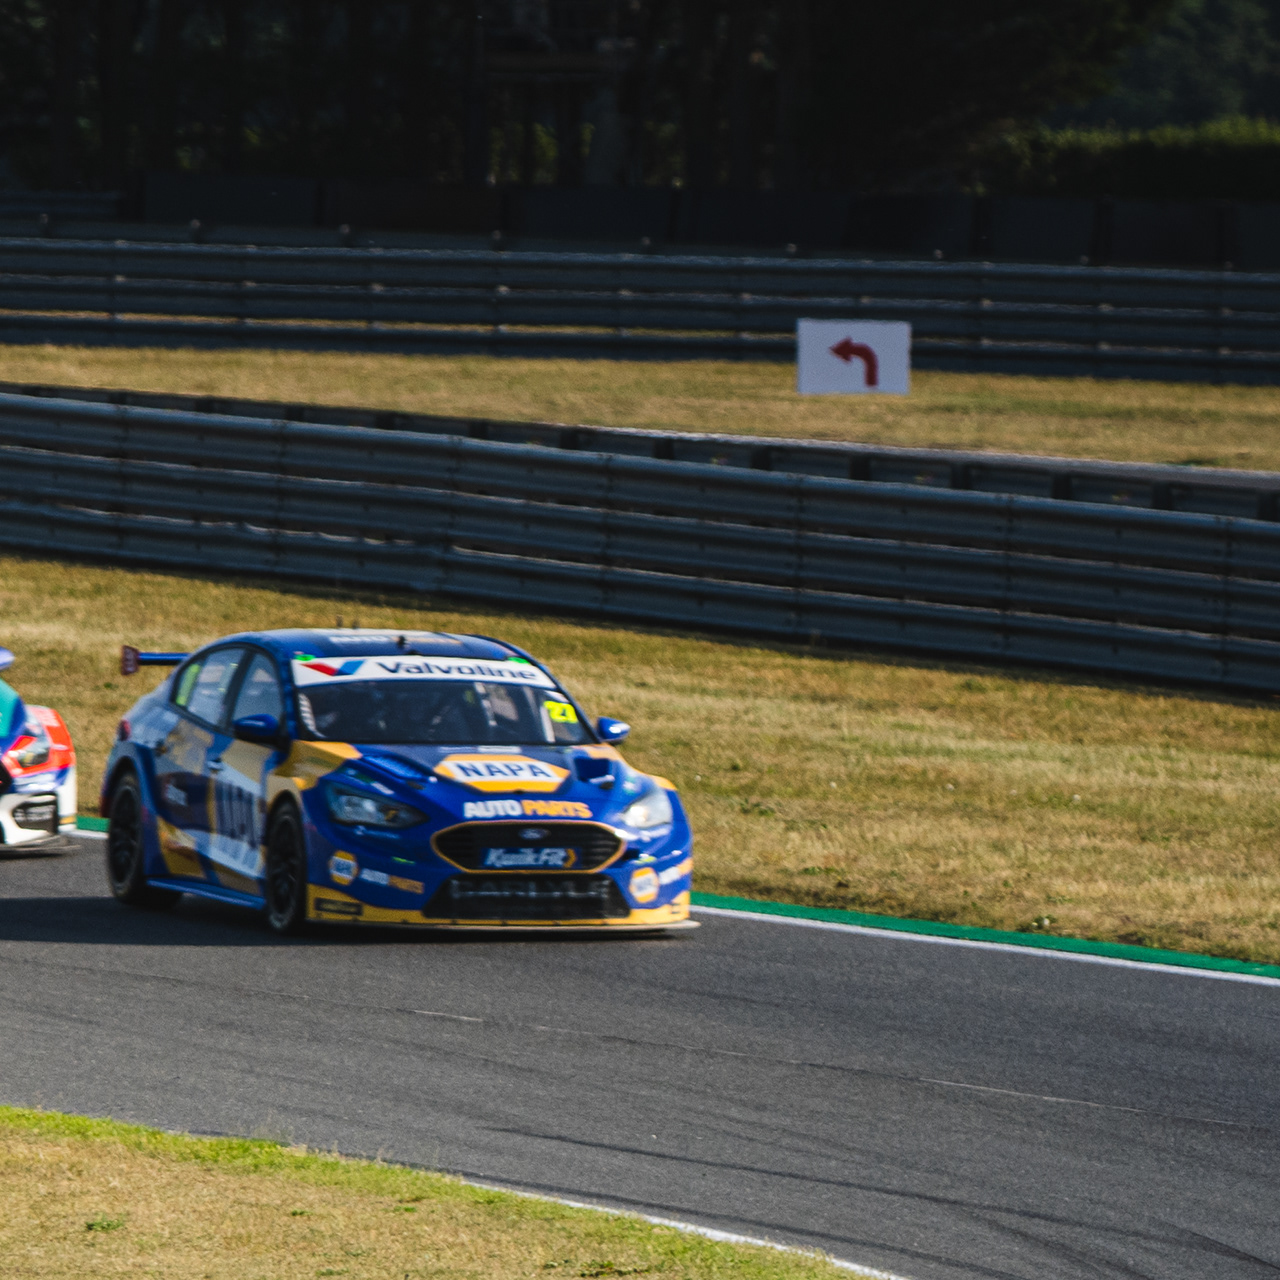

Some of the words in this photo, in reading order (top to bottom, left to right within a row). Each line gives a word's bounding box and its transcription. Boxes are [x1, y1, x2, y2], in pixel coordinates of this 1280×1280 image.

[375, 661, 538, 680] Valvoline
[451, 761, 551, 778] NAPA
[463, 800, 520, 818] AUTO
[521, 800, 593, 818] PARTS
